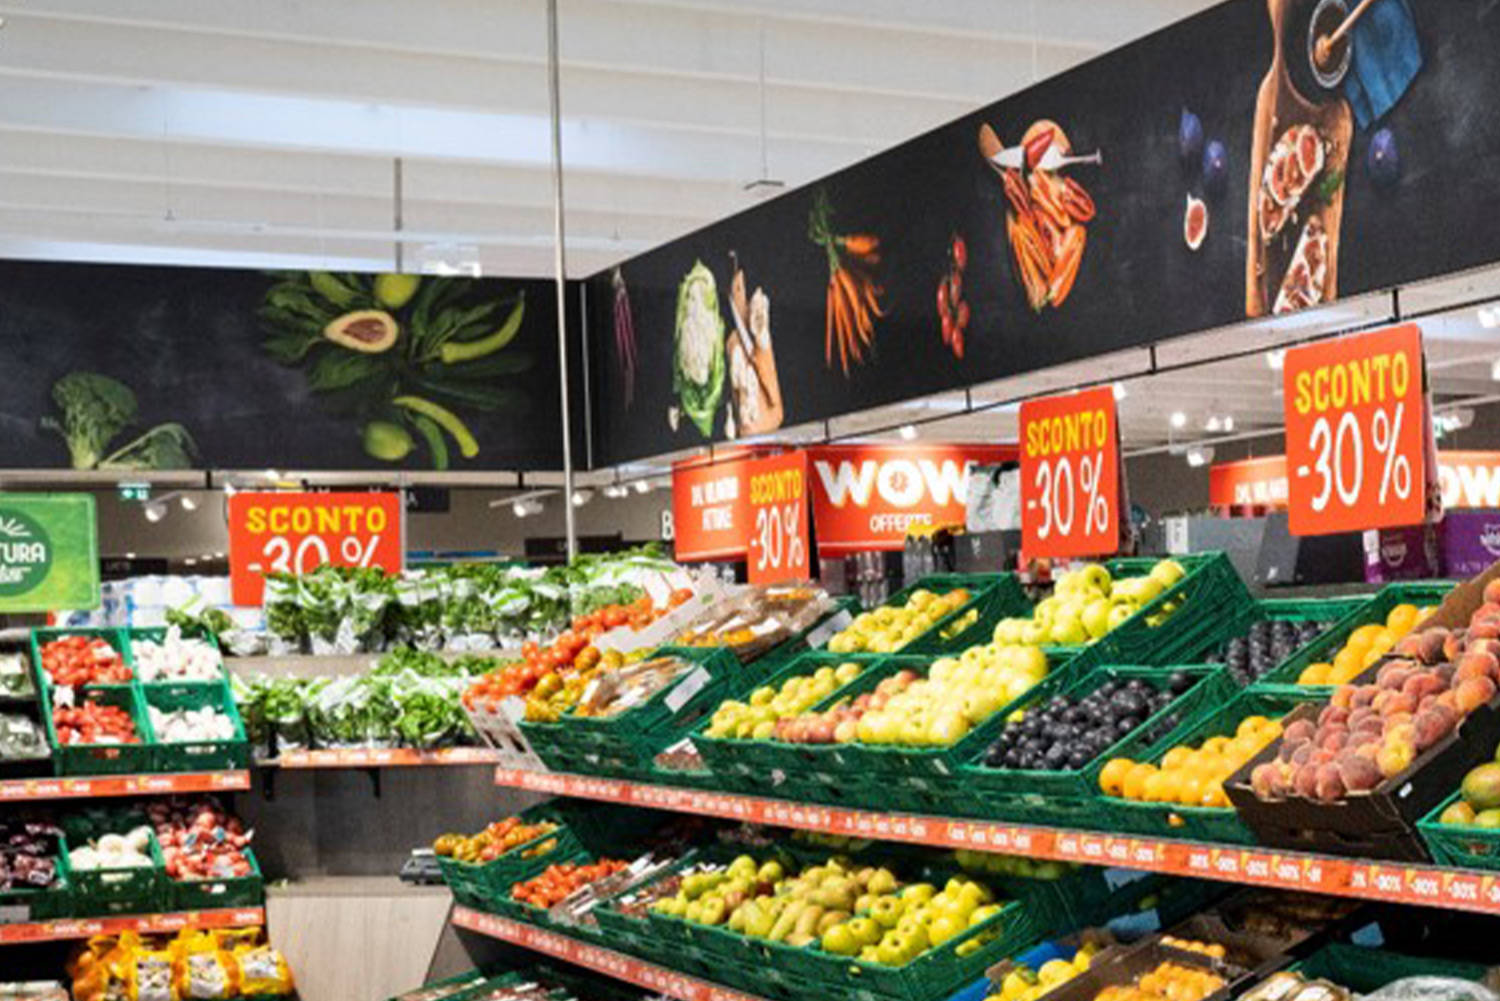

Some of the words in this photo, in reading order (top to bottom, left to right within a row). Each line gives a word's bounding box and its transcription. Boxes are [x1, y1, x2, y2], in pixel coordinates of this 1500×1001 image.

[1295, 351, 1409, 414] SCONTO
[1027, 409, 1107, 457] SCONTO
[1297, 412, 1363, 512] -30
[1373, 403, 1411, 504] %
[750, 469, 801, 504] SCONTO
[814, 459, 976, 507] WOW
[246, 506, 387, 534] SCONTO
